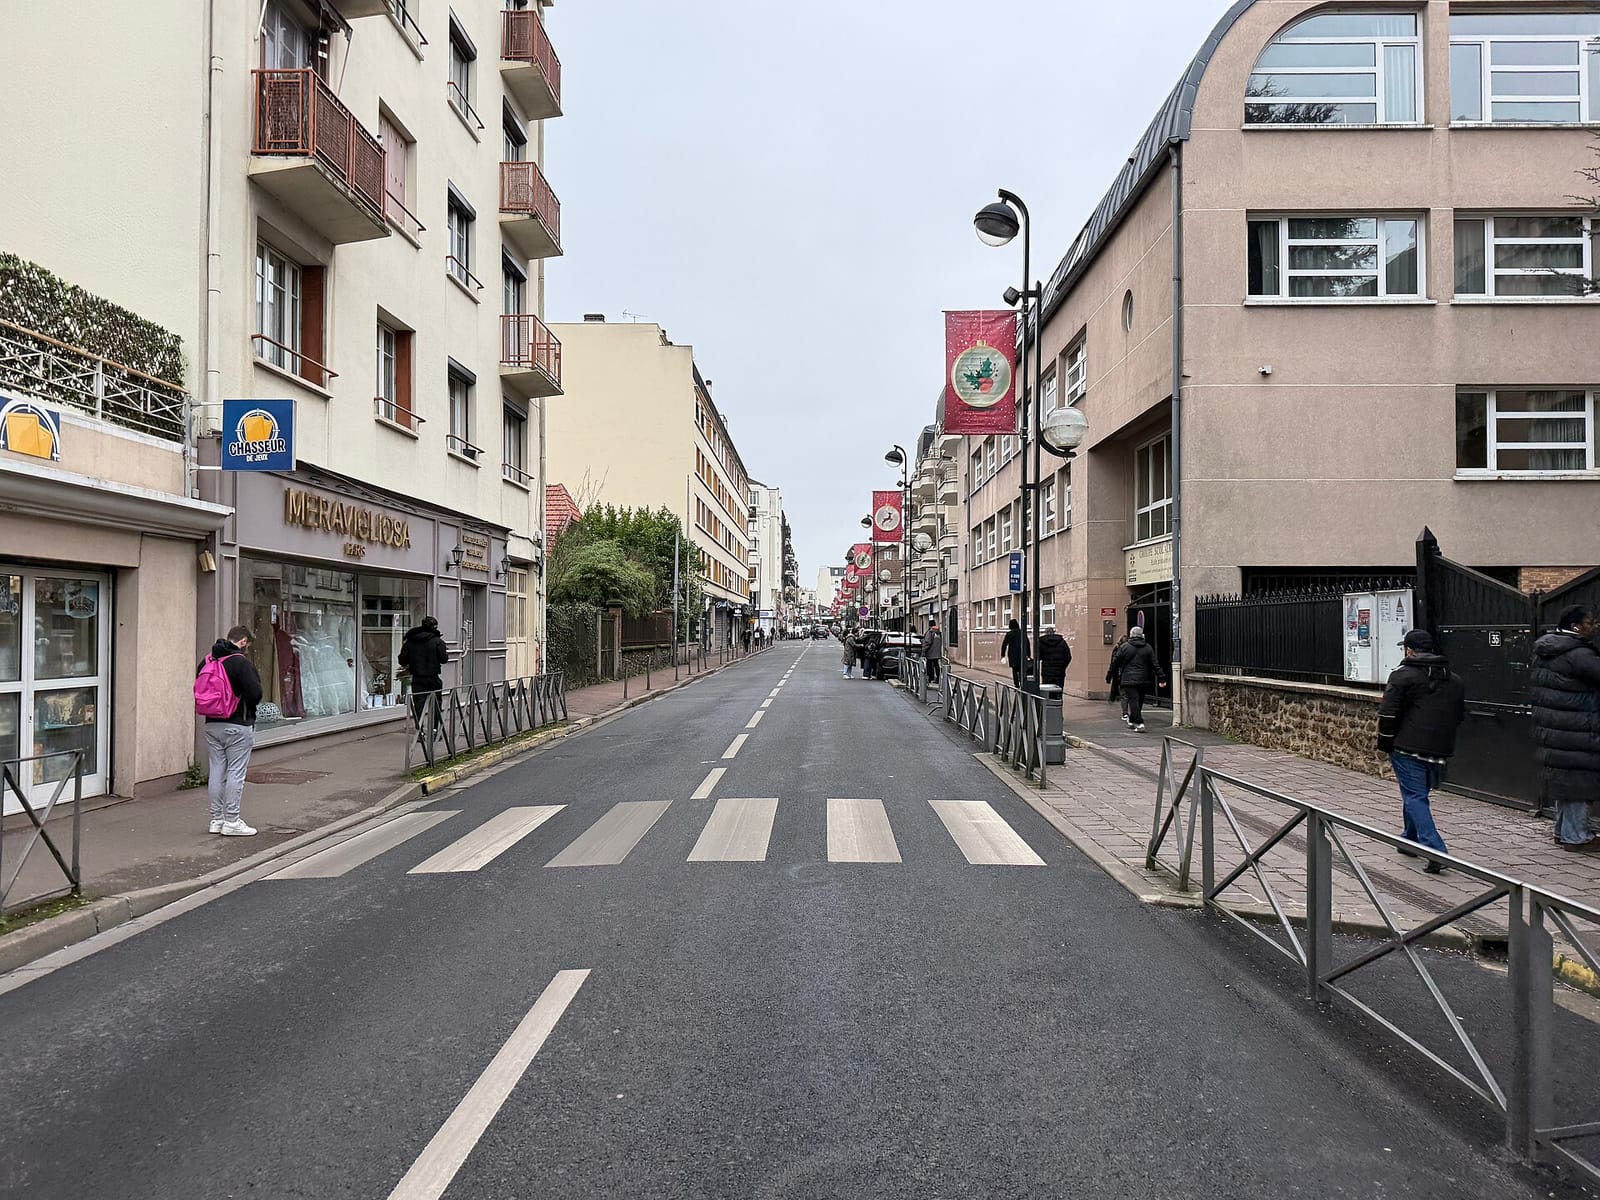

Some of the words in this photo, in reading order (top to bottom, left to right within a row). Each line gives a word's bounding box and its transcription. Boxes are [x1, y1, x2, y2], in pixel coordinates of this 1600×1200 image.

[229, 438, 286, 456] CHASSEUR
[254, 454, 269, 462] JEUX
[285, 488, 411, 549] MERAVIGLIOSA
[344, 542, 366, 559] PARIS
